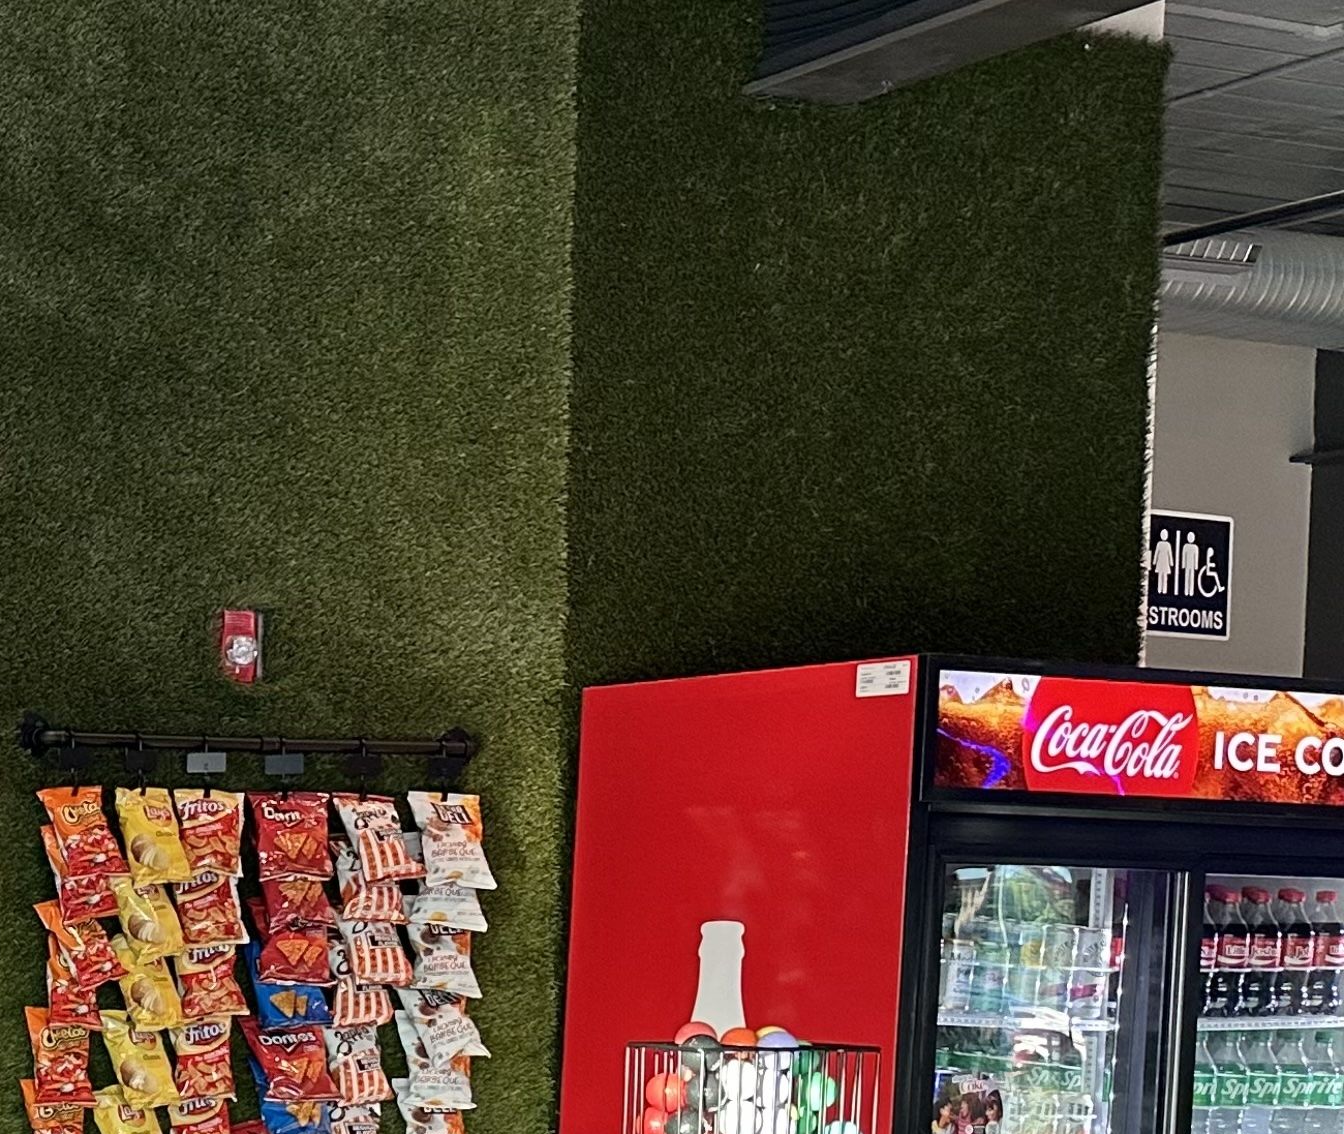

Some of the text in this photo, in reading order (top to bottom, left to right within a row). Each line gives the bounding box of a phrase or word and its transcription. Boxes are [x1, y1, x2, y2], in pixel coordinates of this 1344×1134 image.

[1146, 606, 1223, 630] STROOMS
[1031, 705, 1193, 779] Coca-Cola
[1214, 731, 1282, 774] ICE
[258, 1031, 316, 1046] Doritos
